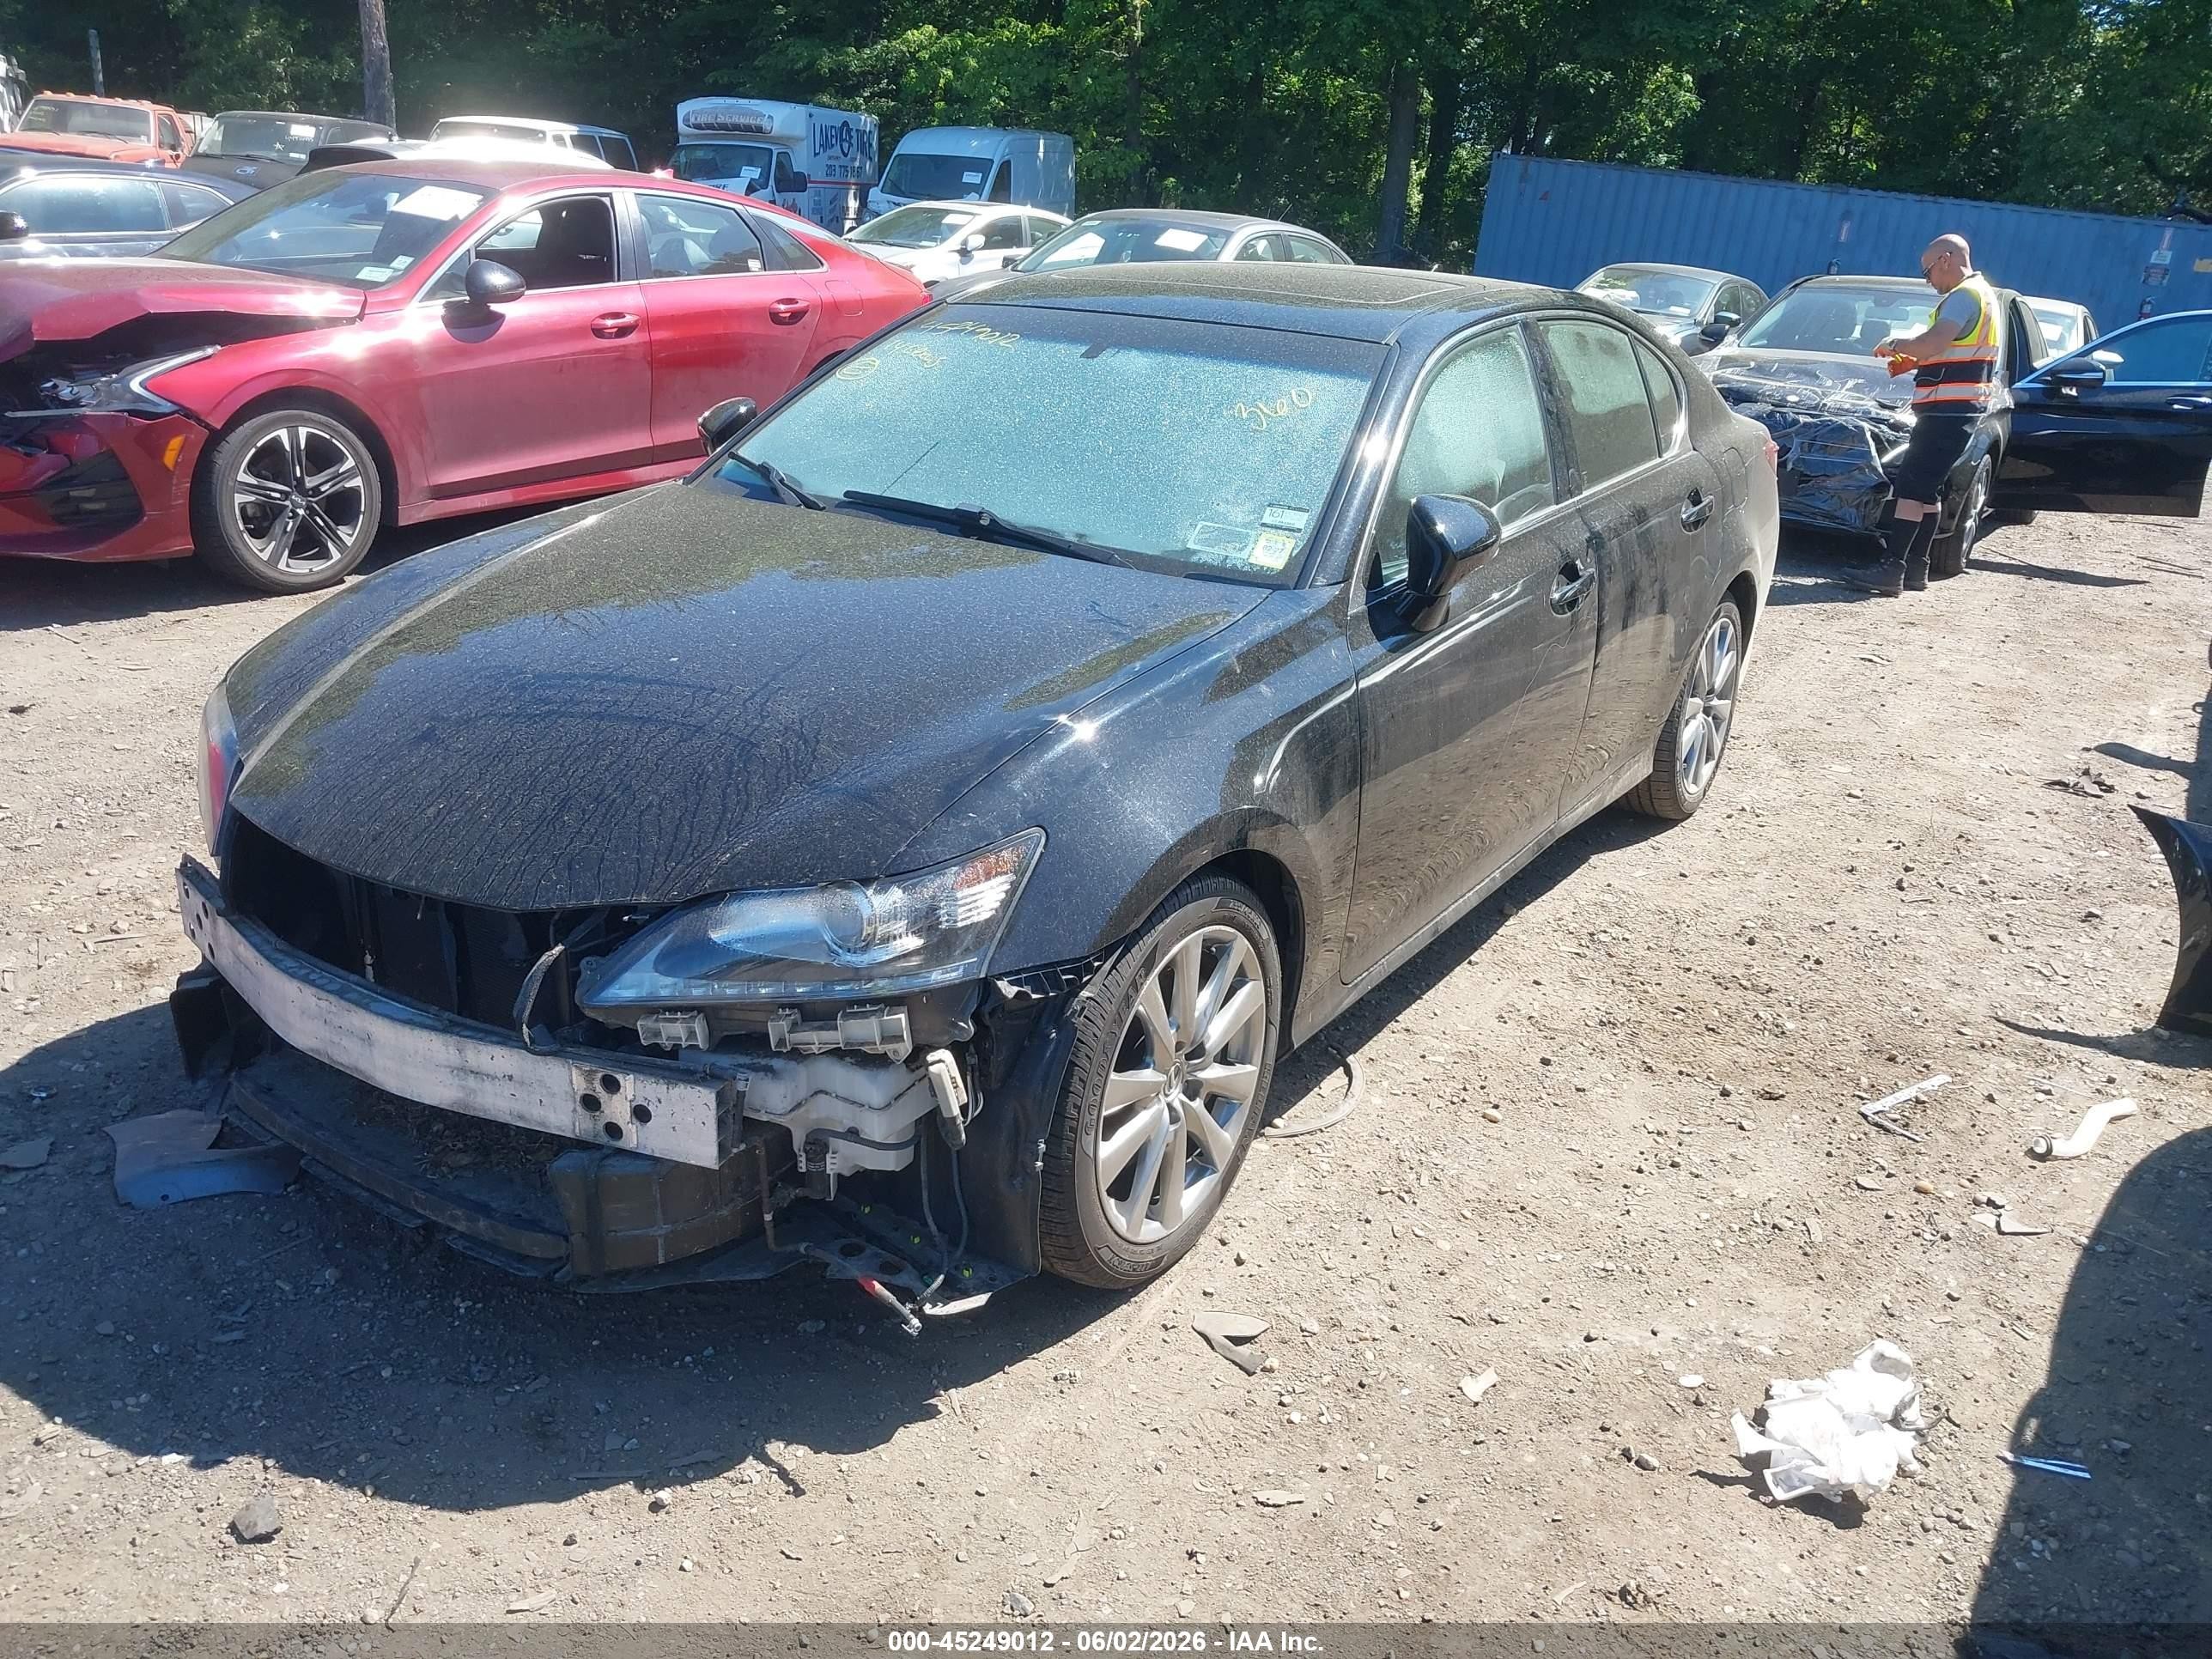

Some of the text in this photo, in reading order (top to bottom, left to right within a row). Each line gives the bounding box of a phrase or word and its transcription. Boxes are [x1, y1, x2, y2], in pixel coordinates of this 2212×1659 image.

[716, 113, 764, 125] SERVICE
[855, 128, 873, 162] TIRE
[1268, 508, 1285, 519] 161
